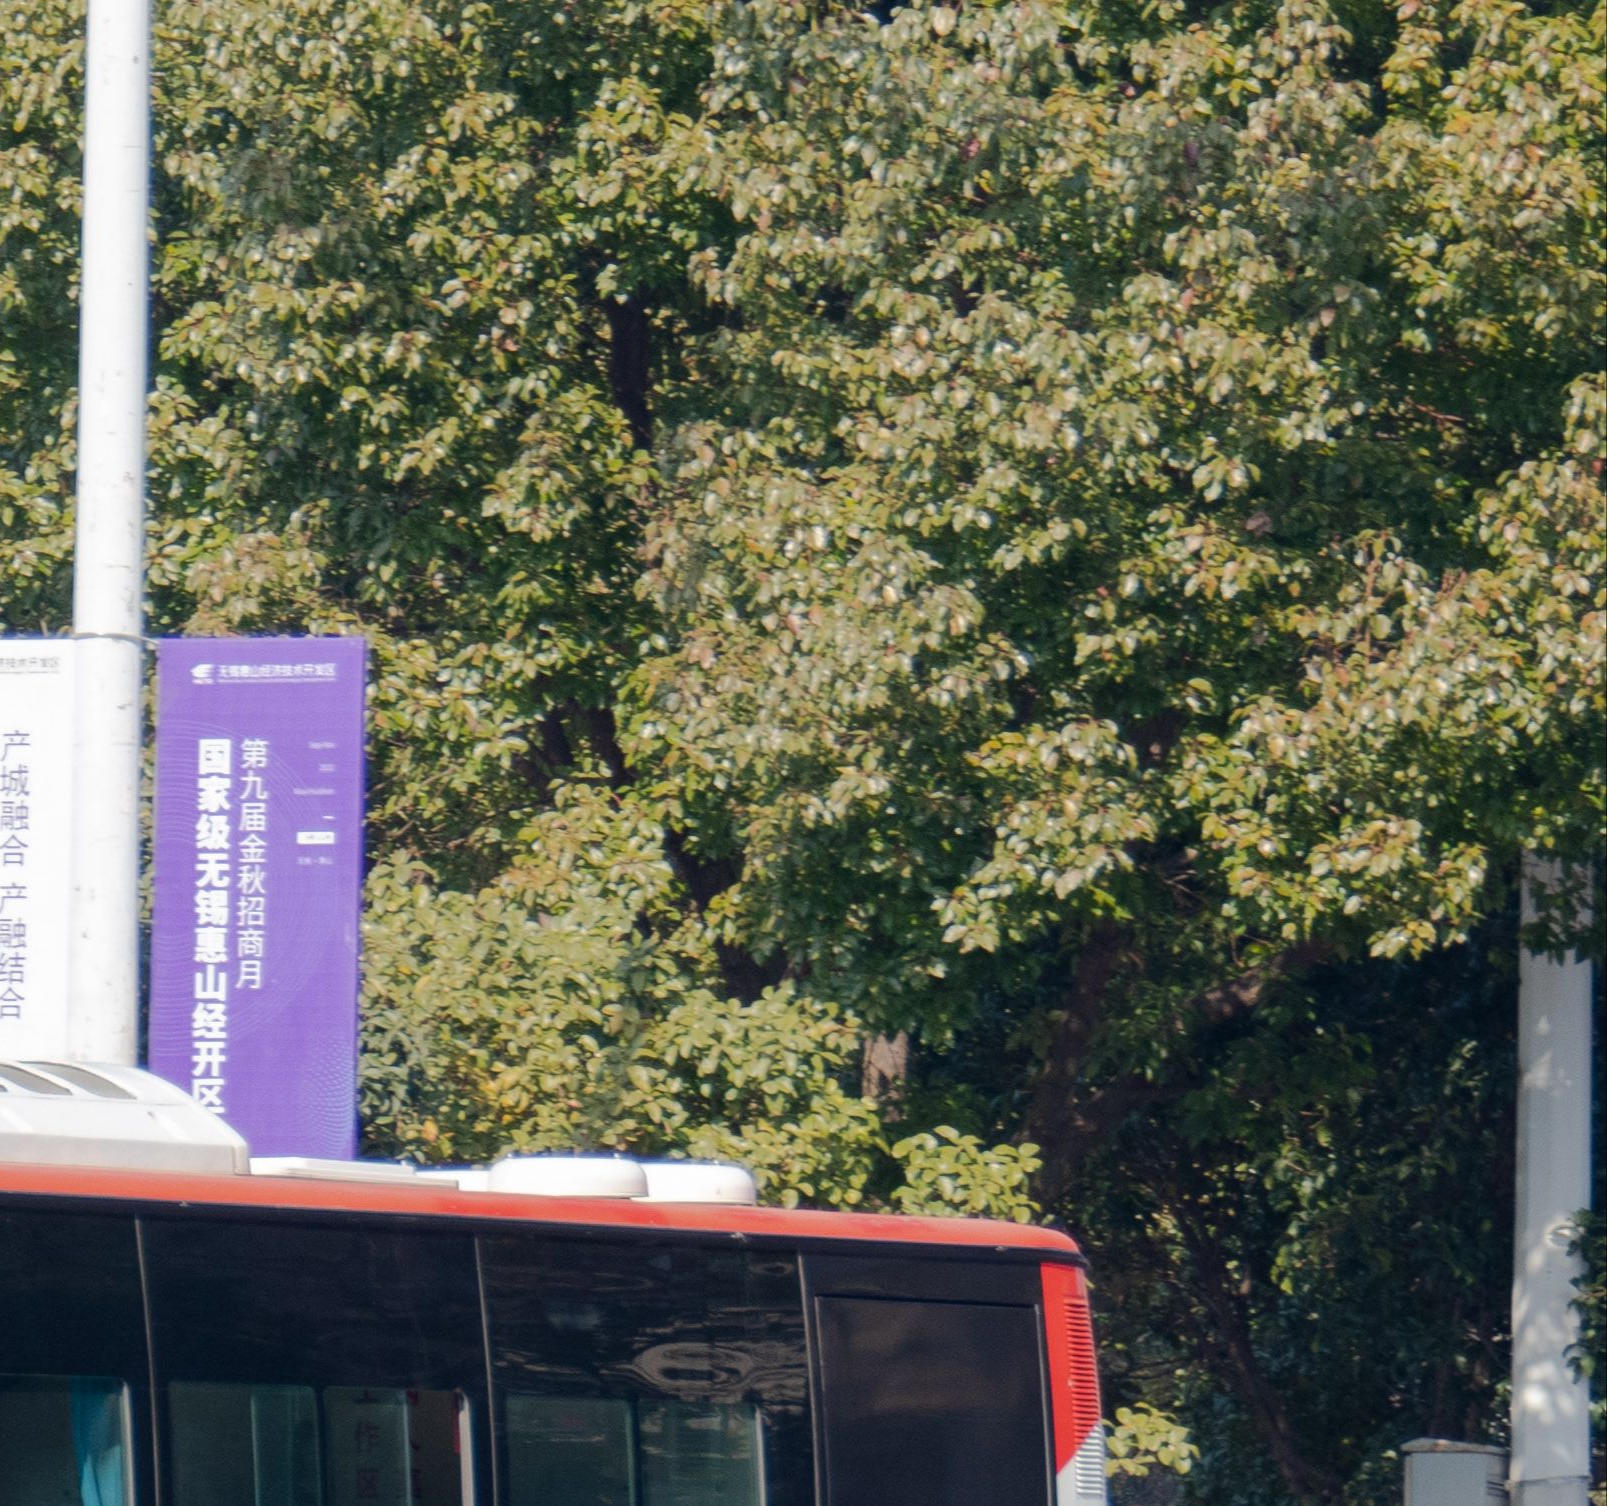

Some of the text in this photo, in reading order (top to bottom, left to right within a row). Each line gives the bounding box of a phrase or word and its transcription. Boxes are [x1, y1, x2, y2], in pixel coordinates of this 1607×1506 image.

[191, 738, 232, 1114] 国家级无锡惠山经开区
[235, 737, 269, 990] 第九届金秋招商月
